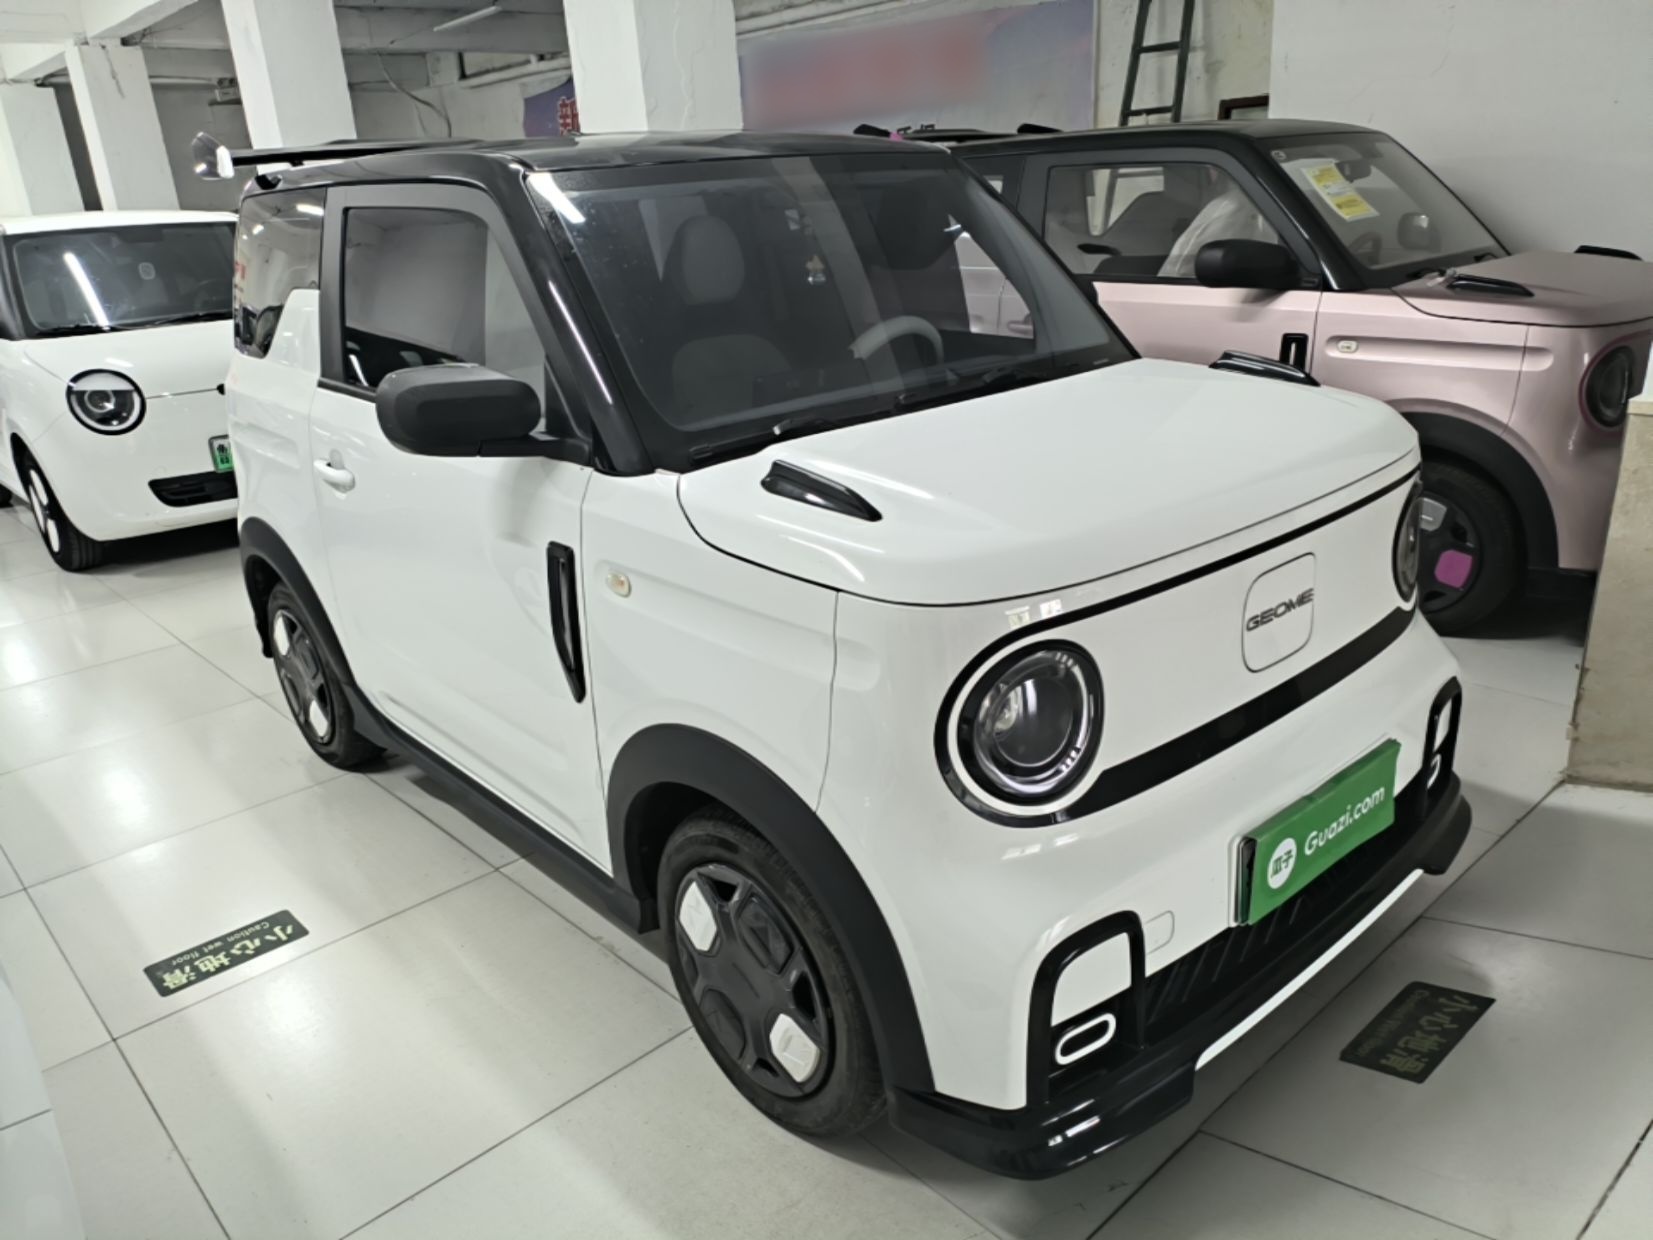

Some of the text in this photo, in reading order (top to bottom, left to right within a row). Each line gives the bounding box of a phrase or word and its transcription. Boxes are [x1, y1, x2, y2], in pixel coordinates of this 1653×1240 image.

[1246, 587, 1314, 632] GEOME
[1304, 787, 1385, 856] Guazi.com
[162, 924, 294, 990] 小心地滑
[172, 921, 270, 966] Caution wet floor
[1379, 995, 1479, 1074] 小心地滑
